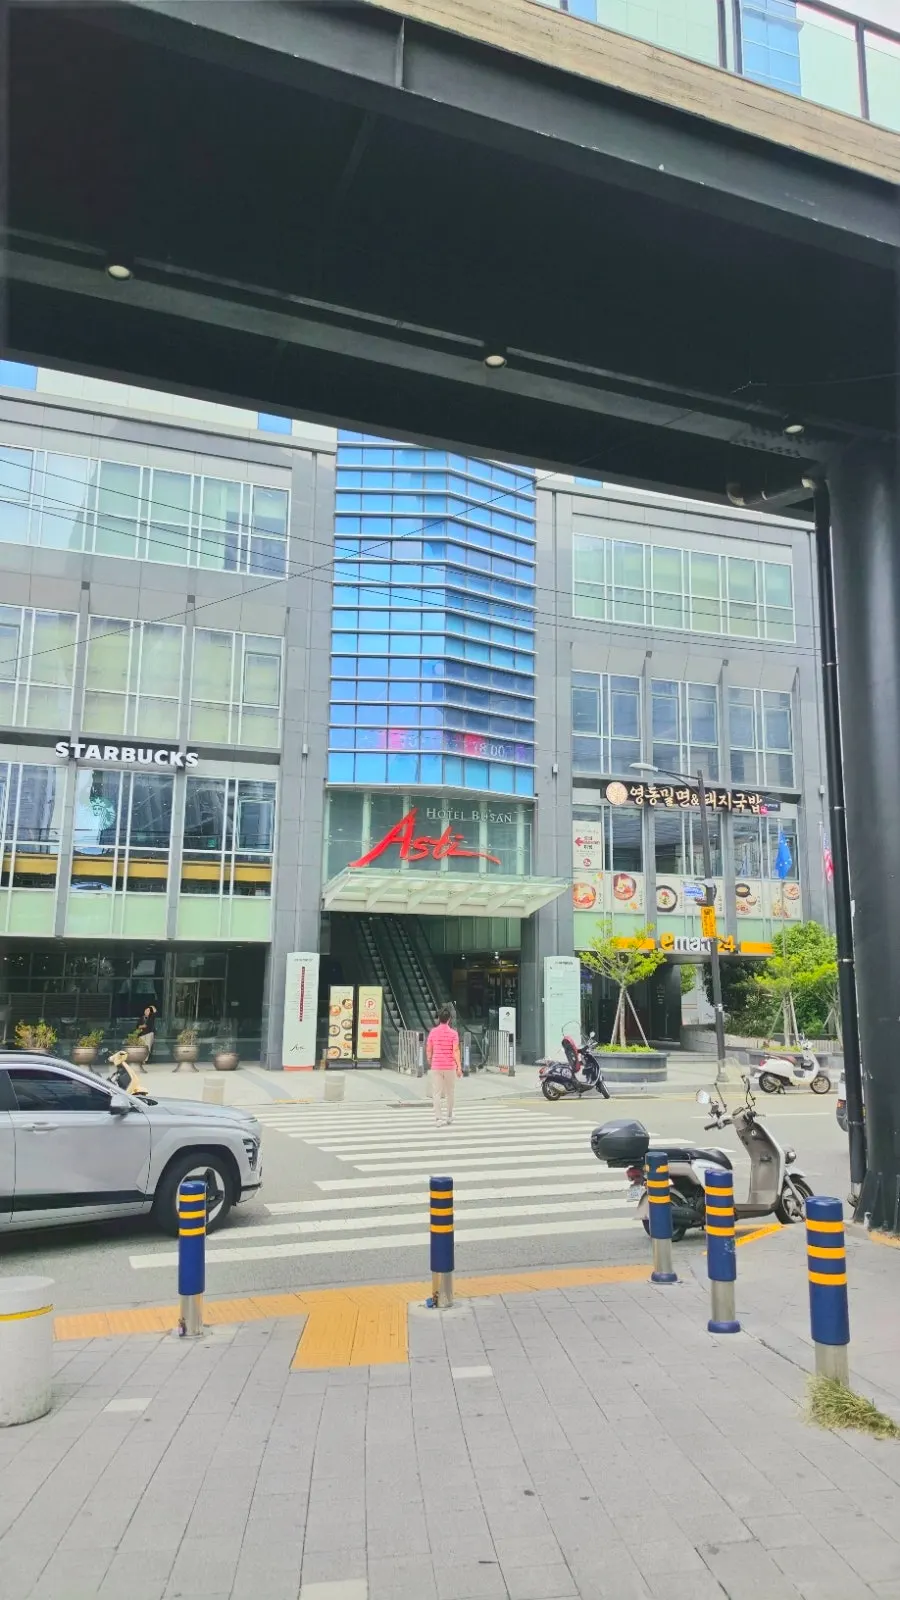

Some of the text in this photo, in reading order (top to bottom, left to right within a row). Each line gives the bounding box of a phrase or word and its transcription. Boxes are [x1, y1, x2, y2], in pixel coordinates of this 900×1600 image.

[55, 741, 199, 768] STARBUCKS
[426, 807, 512, 823] HOTEL BUSAN
[348, 807, 502, 867] Asti
